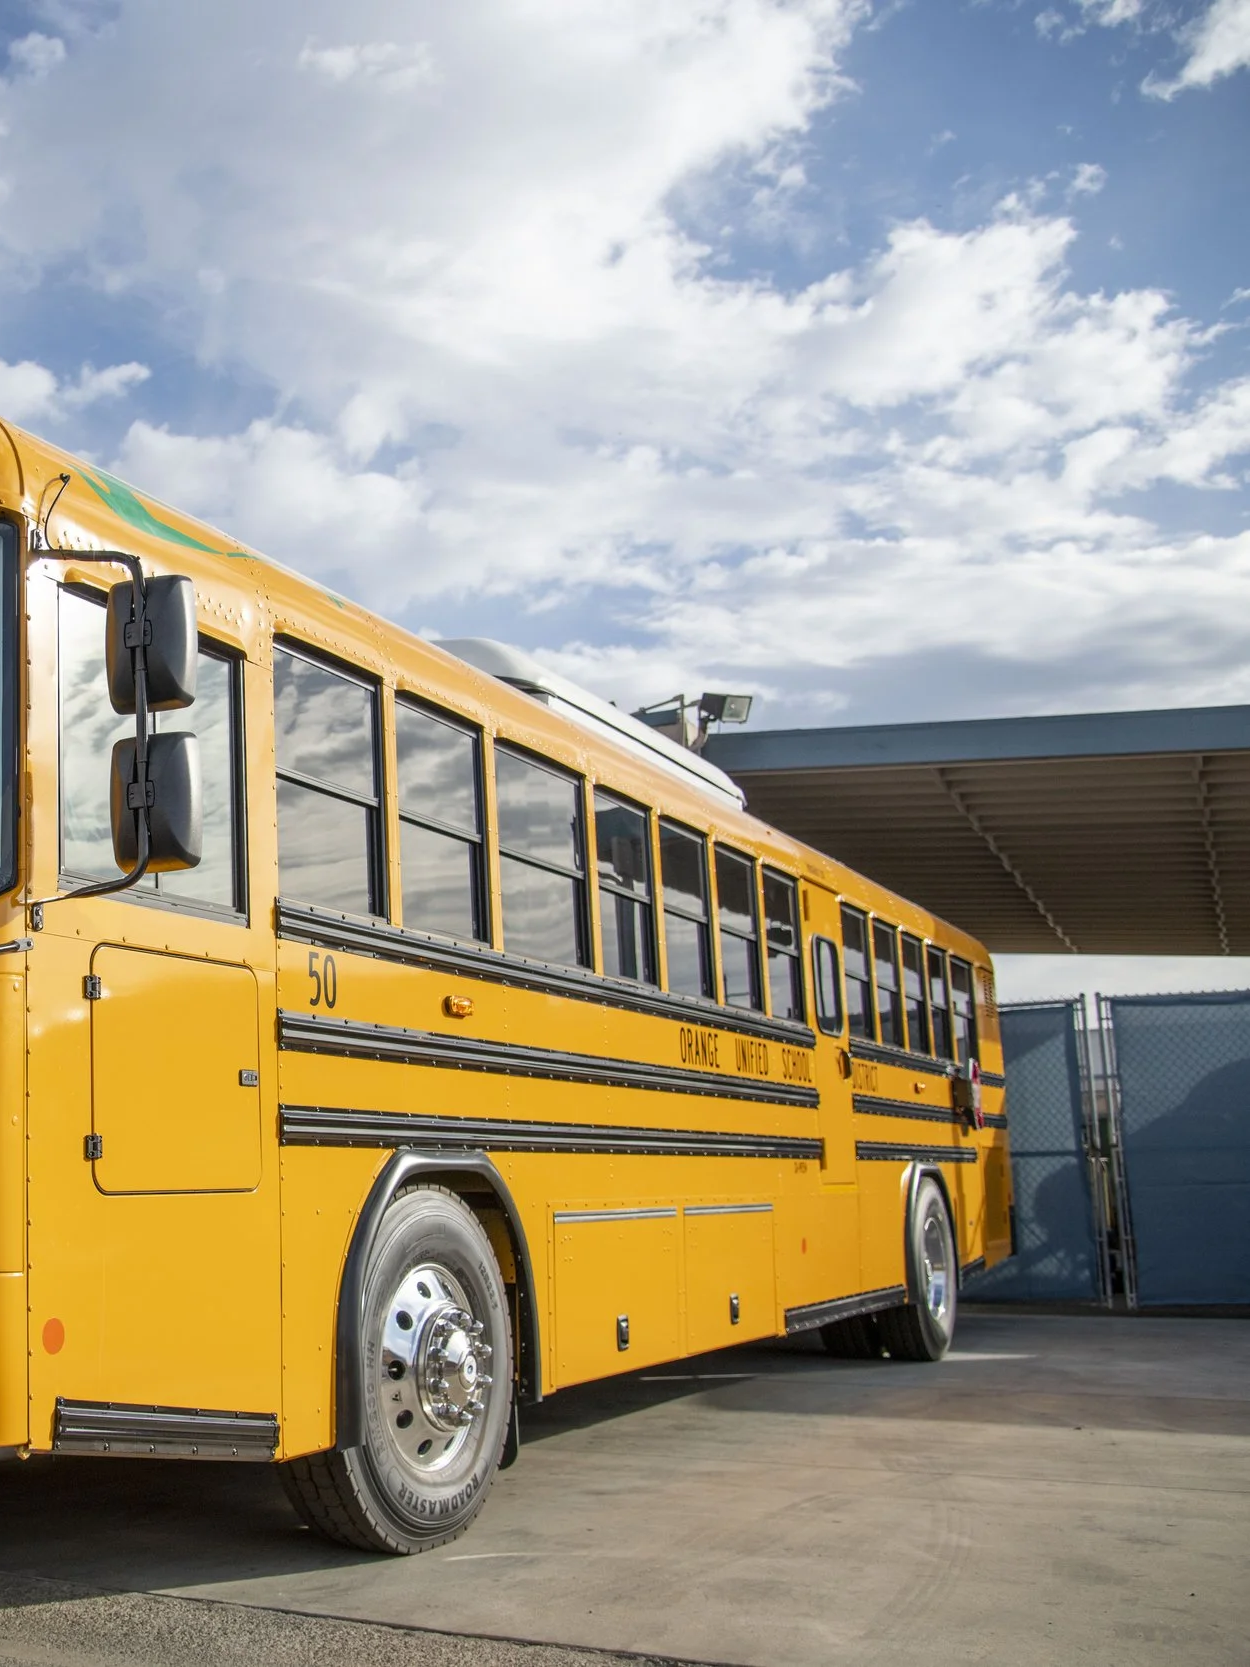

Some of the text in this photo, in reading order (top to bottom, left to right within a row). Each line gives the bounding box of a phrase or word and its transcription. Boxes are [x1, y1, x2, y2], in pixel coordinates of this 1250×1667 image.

[309, 951, 337, 1009] 50
[679, 1027, 720, 1069] ORANGE
[735, 1038, 769, 1076] UNIFIED
[782, 1048, 812, 1083] SCHOOL
[398, 1472, 479, 1515] ROADMASTER
